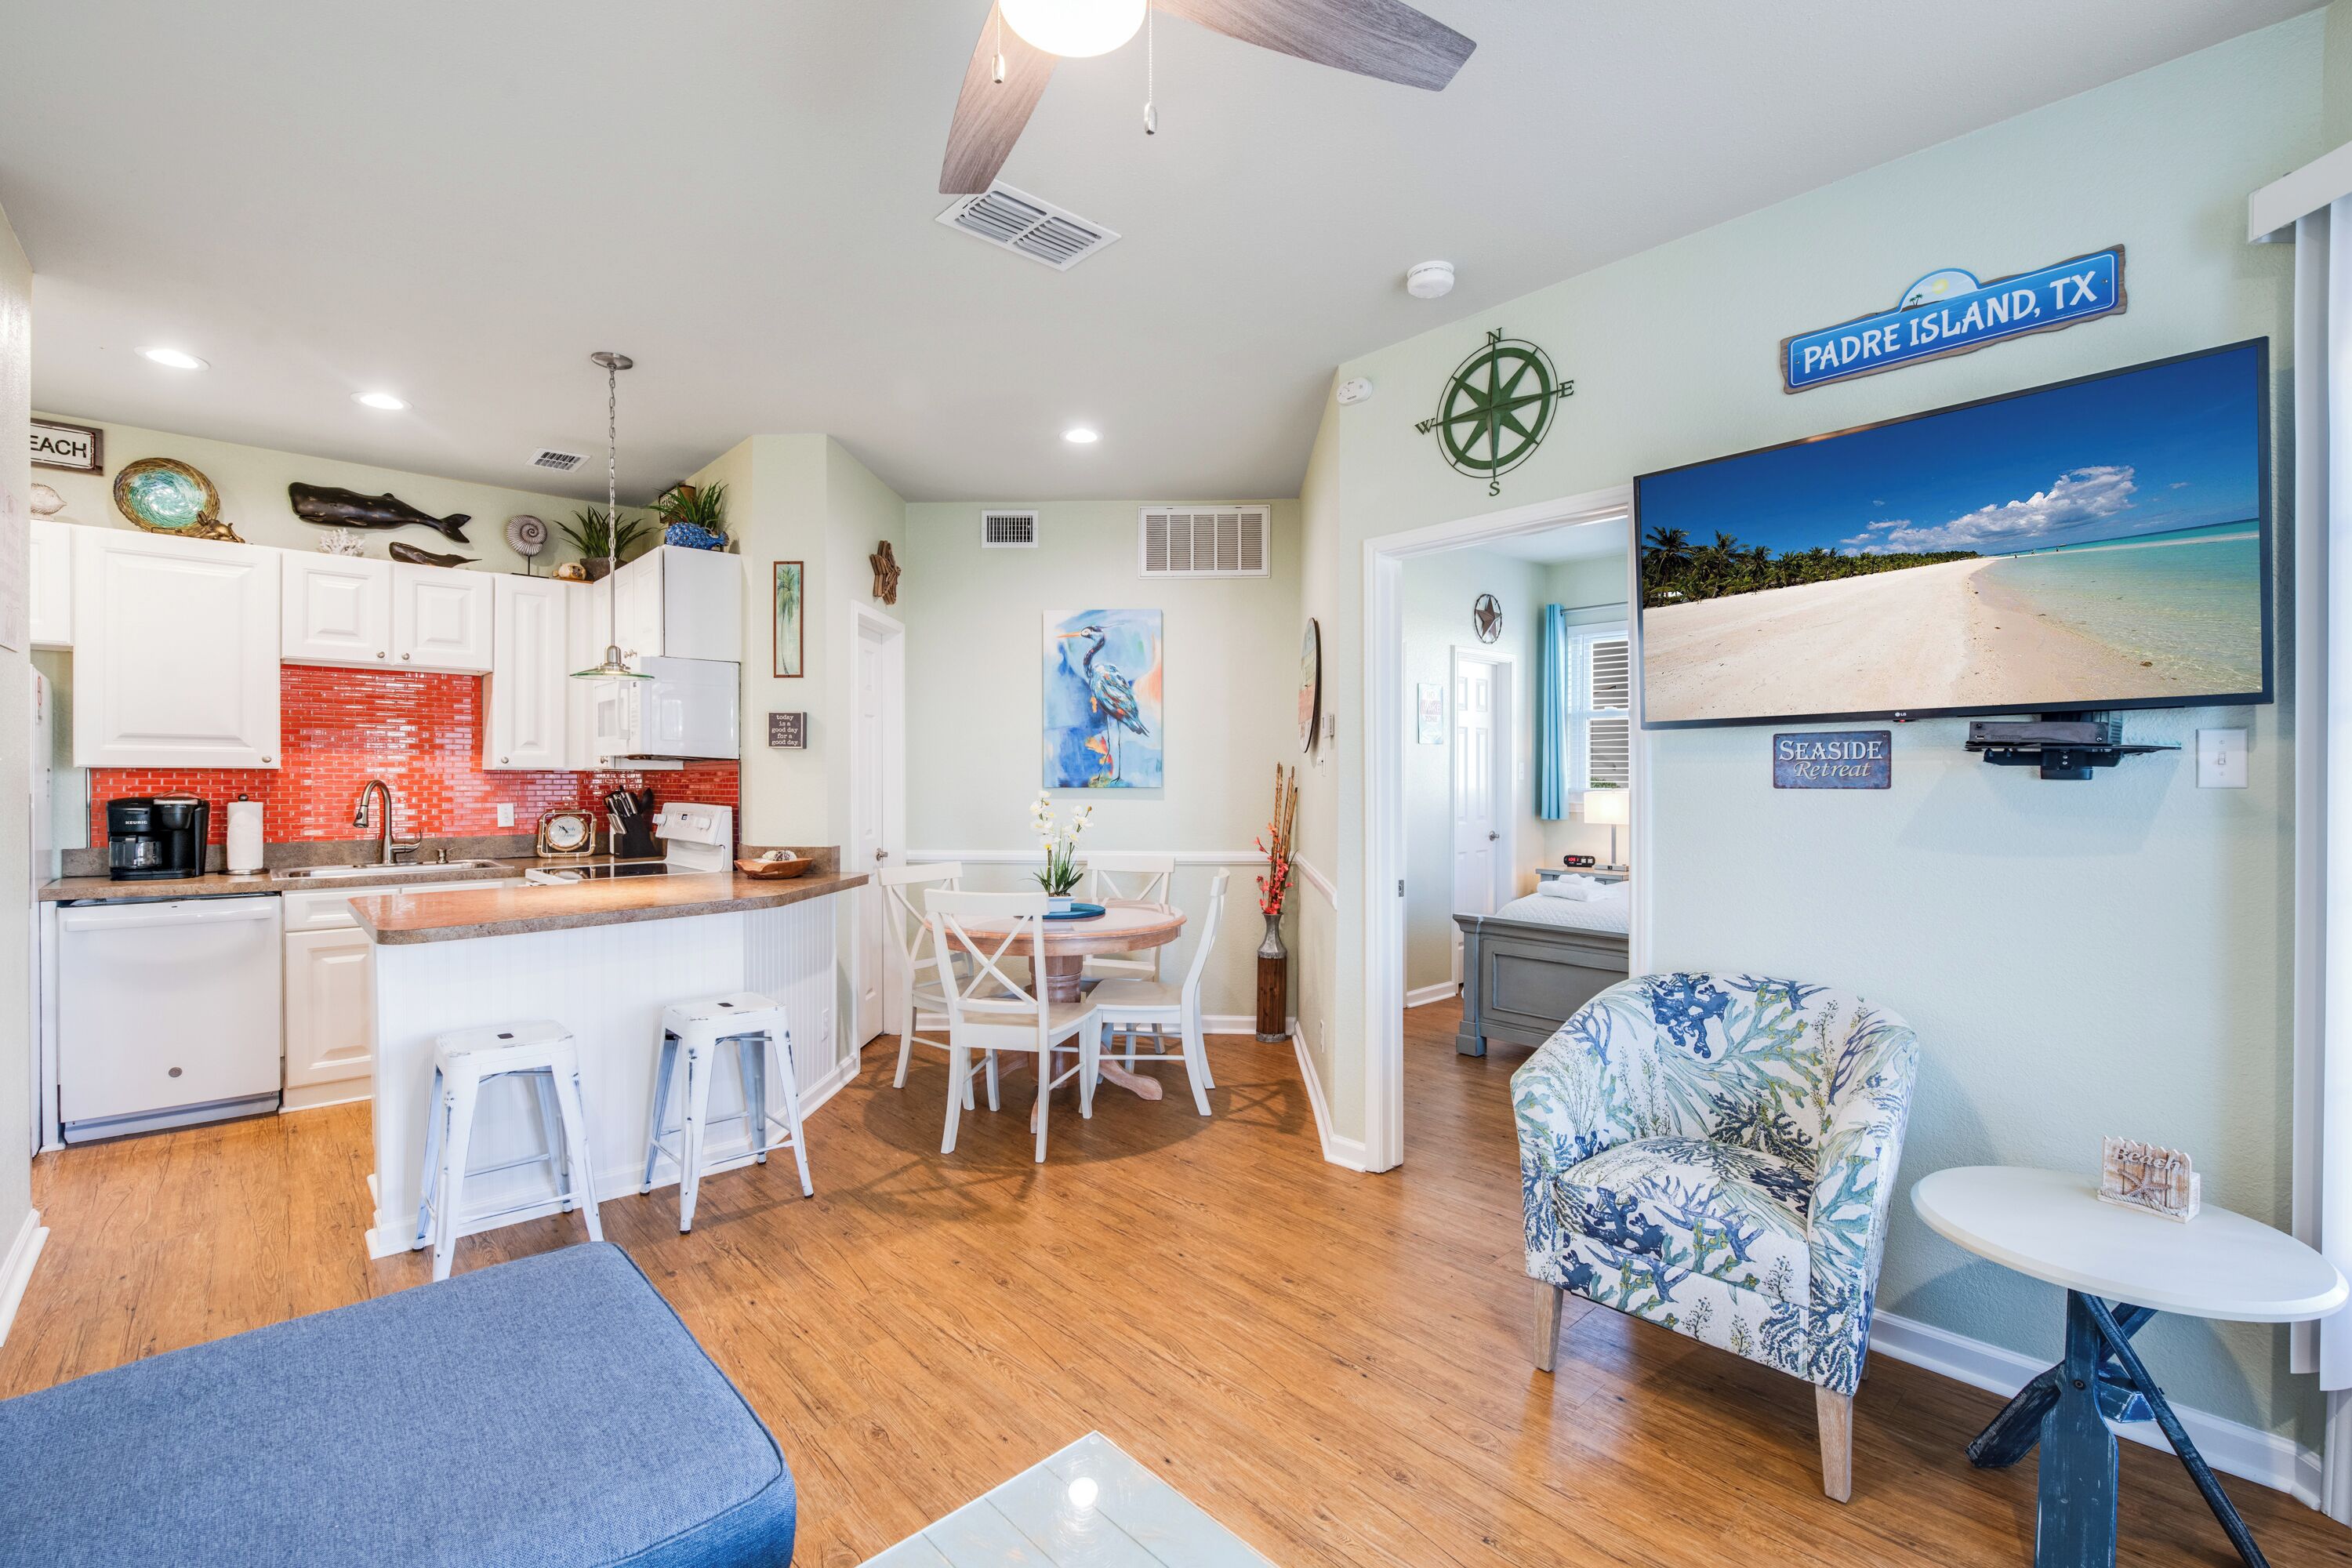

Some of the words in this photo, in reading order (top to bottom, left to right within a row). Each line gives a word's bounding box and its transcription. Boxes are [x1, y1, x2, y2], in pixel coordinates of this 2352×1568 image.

[1805, 323, 1900, 374] PADRE
[1910, 289, 2041, 347] ISLAND,
[2049, 270, 2098, 310] TX
[1486, 327, 1502, 346] N
[1559, 379, 1574, 398] E
[1414, 418, 1436, 435] W
[1489, 481, 1501, 497] S
[1421, 702, 1442, 713] WAKE
[1779, 740, 1884, 760] SEASIDE
[1794, 760, 1872, 780] Retreat
[2114, 1148, 2181, 1171] Beach
